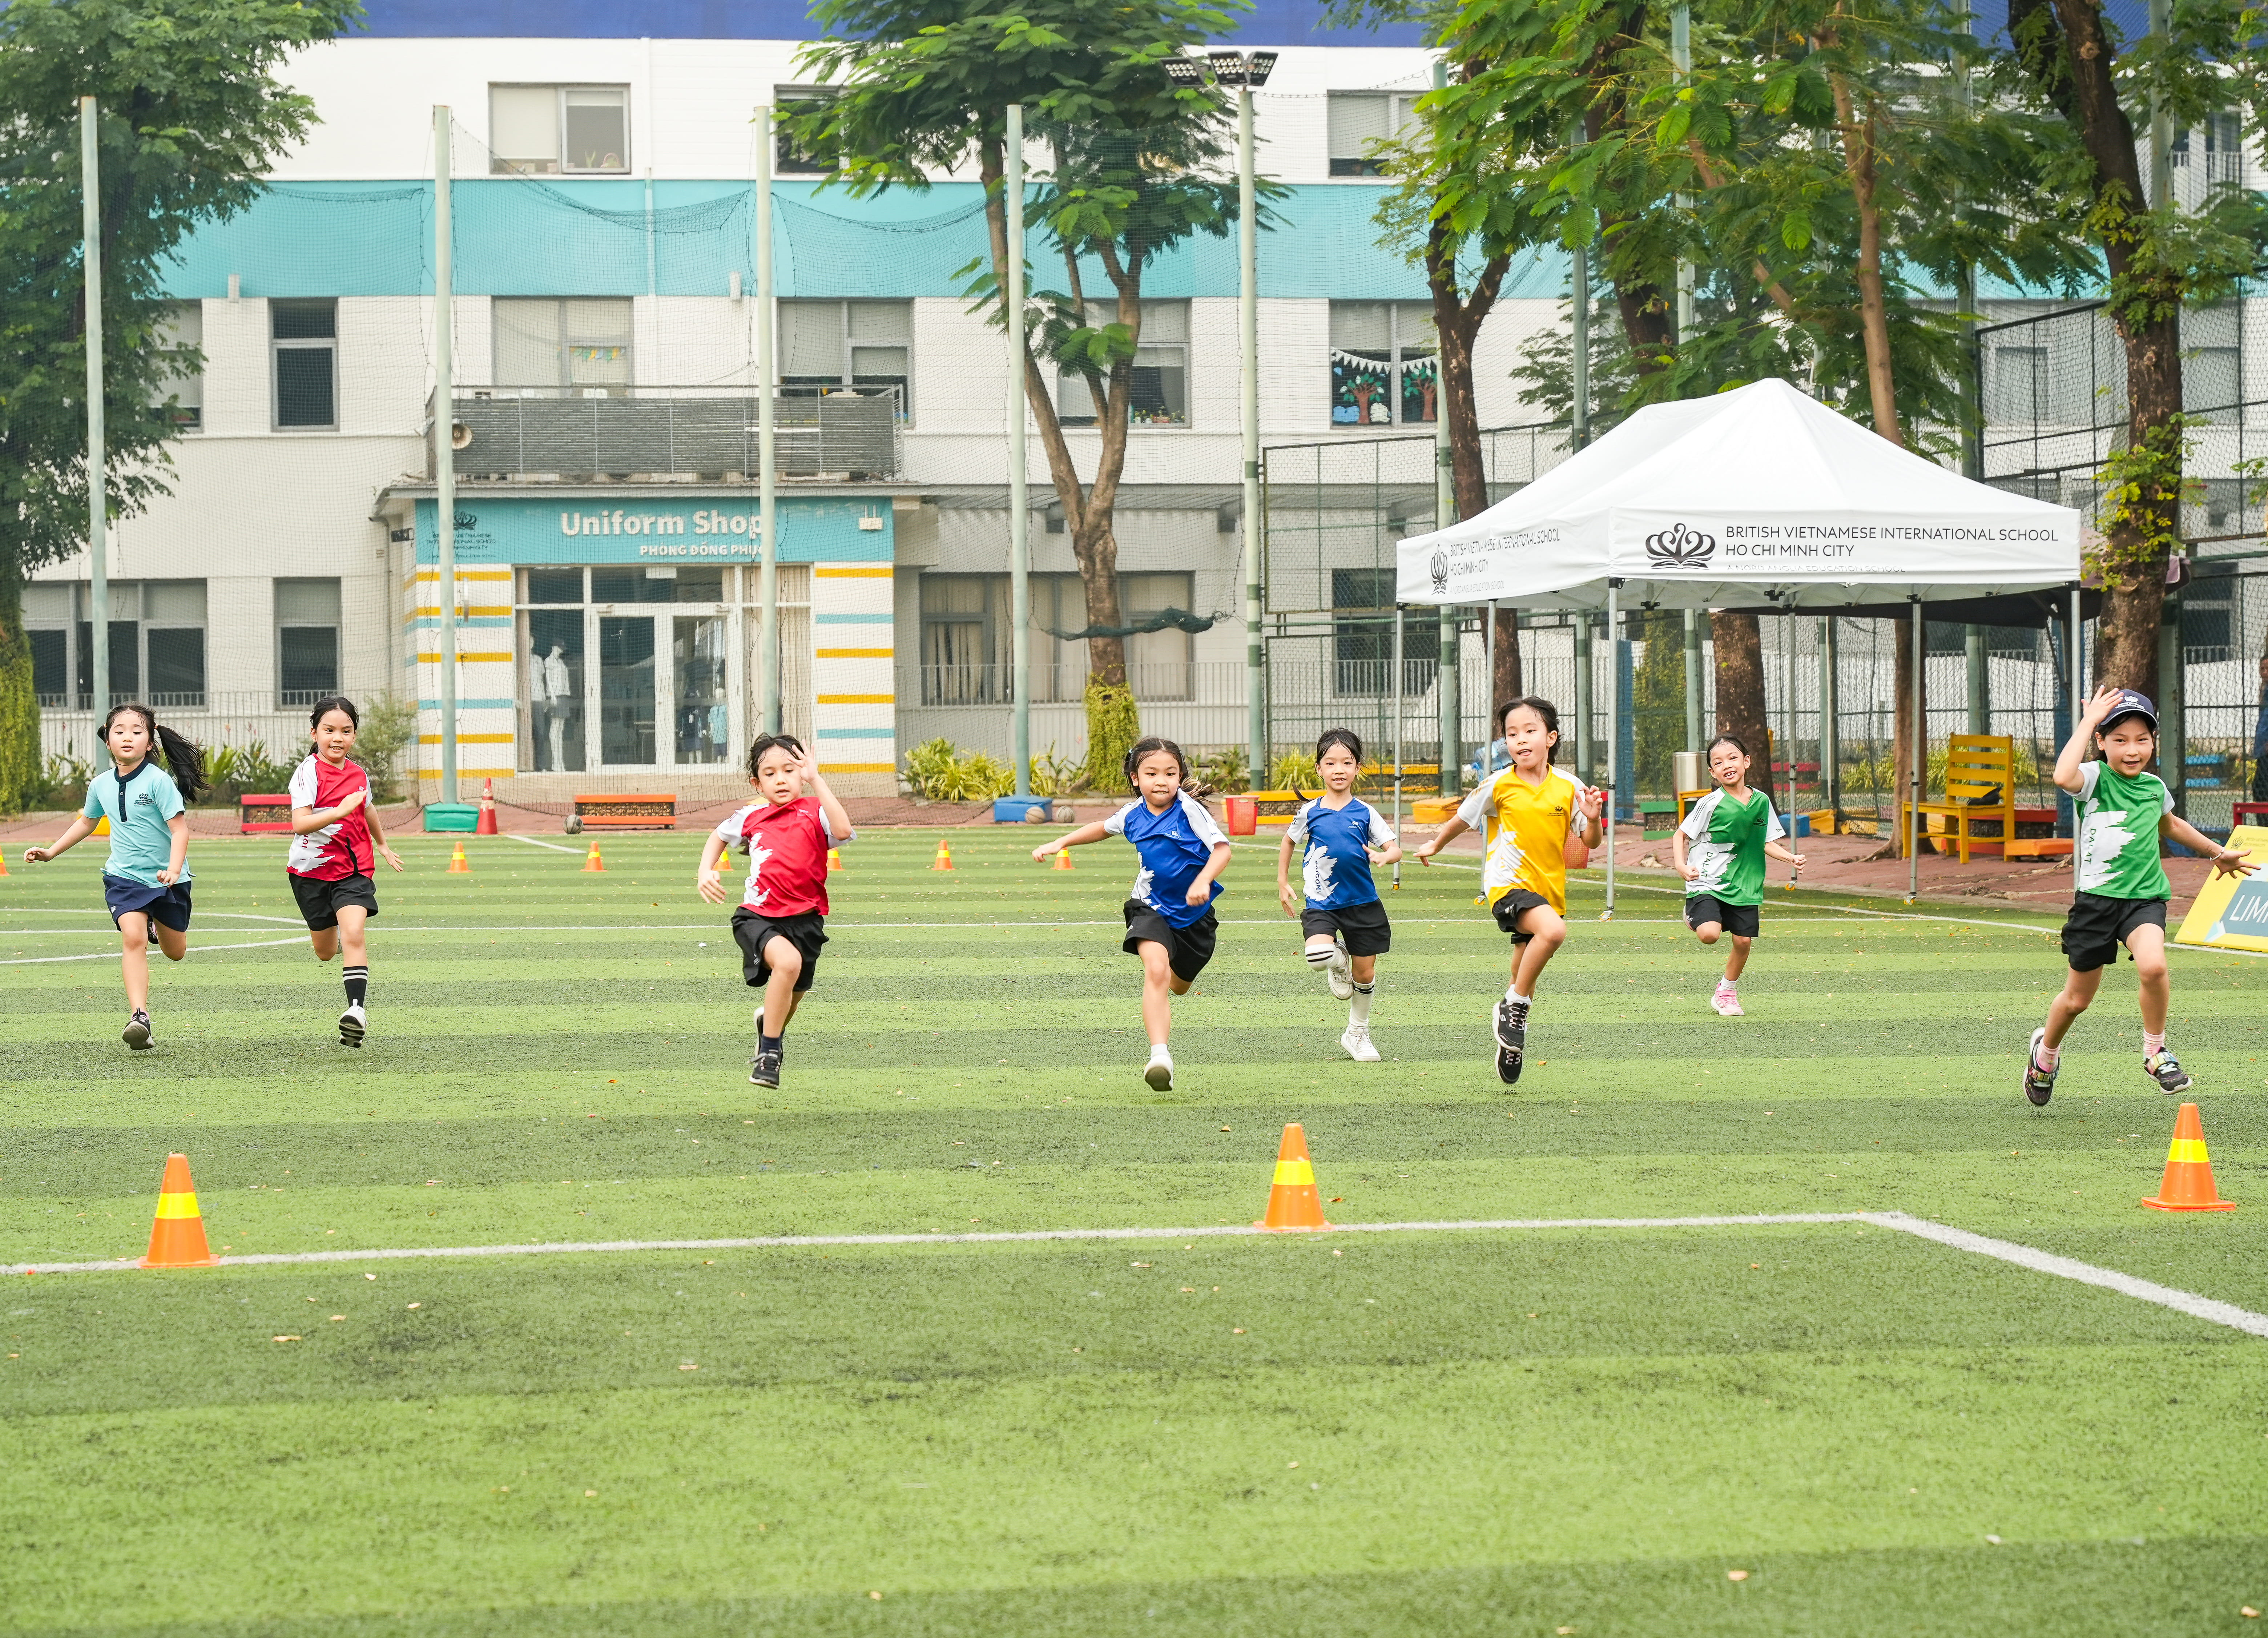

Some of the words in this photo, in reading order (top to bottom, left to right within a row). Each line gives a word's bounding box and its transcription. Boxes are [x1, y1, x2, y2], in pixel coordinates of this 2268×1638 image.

[561, 510, 684, 536] Uniform
[693, 510, 761, 539] Shop
[1726, 526, 1780, 538] BRITISH
[1784, 527, 1876, 539] VIETNAMESE
[1881, 527, 1995, 540] INTERNATIONAL
[1999, 529, 2058, 541] SCHOOL
[1450, 543, 1467, 557] BRITISH
[1468, 538, 1496, 554] VIETNAMESE
[1496, 532, 1536, 550] INTERNATIONAL
[1537, 528, 1560, 544] SCHOOL
[1726, 544, 1747, 556] HO
[1752, 544, 1776, 556] CHI
[1780, 545, 1818, 556] MINH
[1822, 545, 1854, 556] CITY
[1450, 563, 1457, 576] HO
[1466, 560, 1478, 575] MINH
[1479, 558, 1488, 572] CITY
[1701, 852, 1713, 879] DALAT
